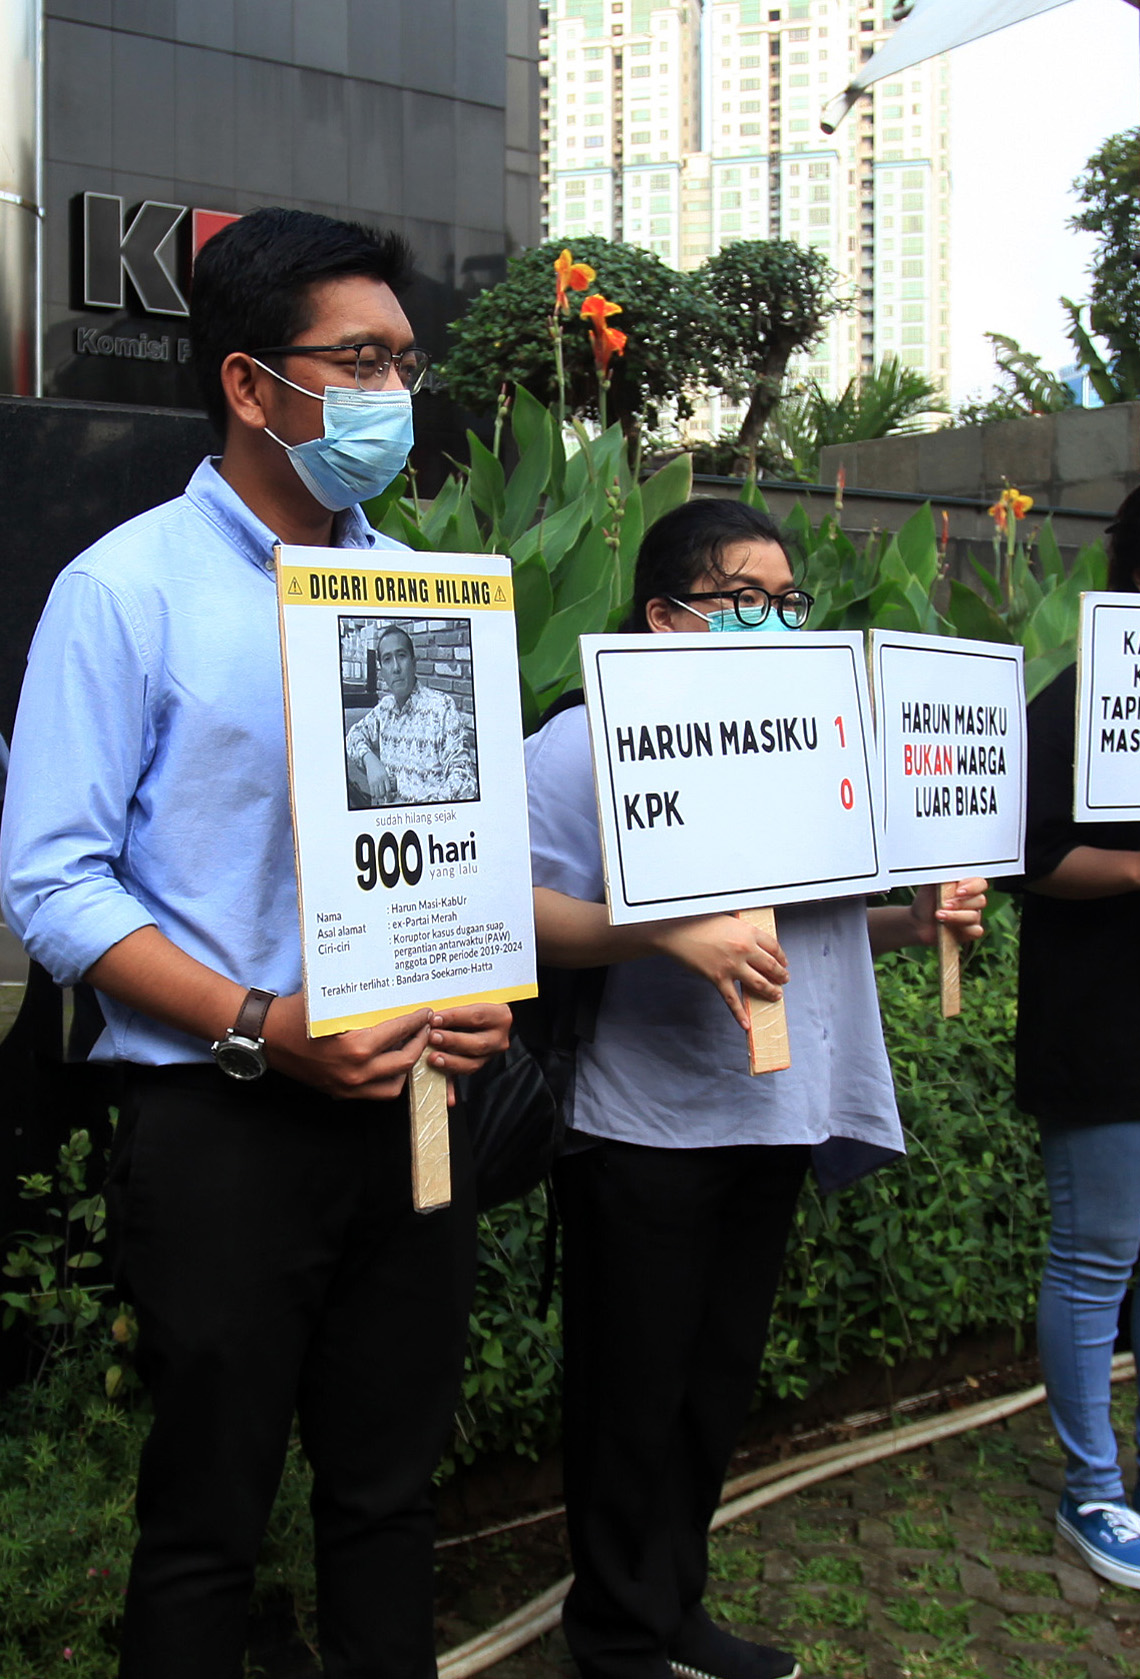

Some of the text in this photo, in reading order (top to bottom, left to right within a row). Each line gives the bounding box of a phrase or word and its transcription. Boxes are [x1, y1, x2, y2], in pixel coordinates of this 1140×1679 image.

[76, 327, 169, 361] Komisi
[309, 574, 491, 605] DICARI ORANG HILANG
[901, 701, 1008, 736] HARUN MASIKU
[616, 716, 846, 762] HARUN MASIKU 1
[904, 744, 1007, 776] BUKAN WARGA
[623, 778, 854, 830] KPK 0
[915, 785, 998, 818] LUAR BIASA
[375, 809, 457, 827] sudah hilang sejak
[355, 829, 476, 891] 900 hari
[429, 863, 478, 880] yang lalu
[316, 912, 342, 923] Nama
[391, 902, 417, 914] Harun
[418, 895, 467, 910] Masi-KabUr
[317, 927, 336, 939] Asal
[338, 924, 367, 937] alamat
[392, 914, 430, 929] ex-Partai
[431, 911, 458, 923] Merah
[318, 940, 351, 955] Ciri-ciri
[393, 931, 431, 944] Koruptor
[432, 928, 455, 939] kasus
[456, 925, 485, 936] dugaan
[486, 922, 504, 932] suap
[394, 930, 511, 959] pergantian antarwaktu (PAW)
[394, 941, 523, 970] anggota DPR periode 2019-2024
[321, 982, 358, 997] Terakhir
[359, 977, 390, 991] terlihat
[396, 972, 430, 985] Bandara
[431, 962, 493, 980] Soekarno-Hatta
